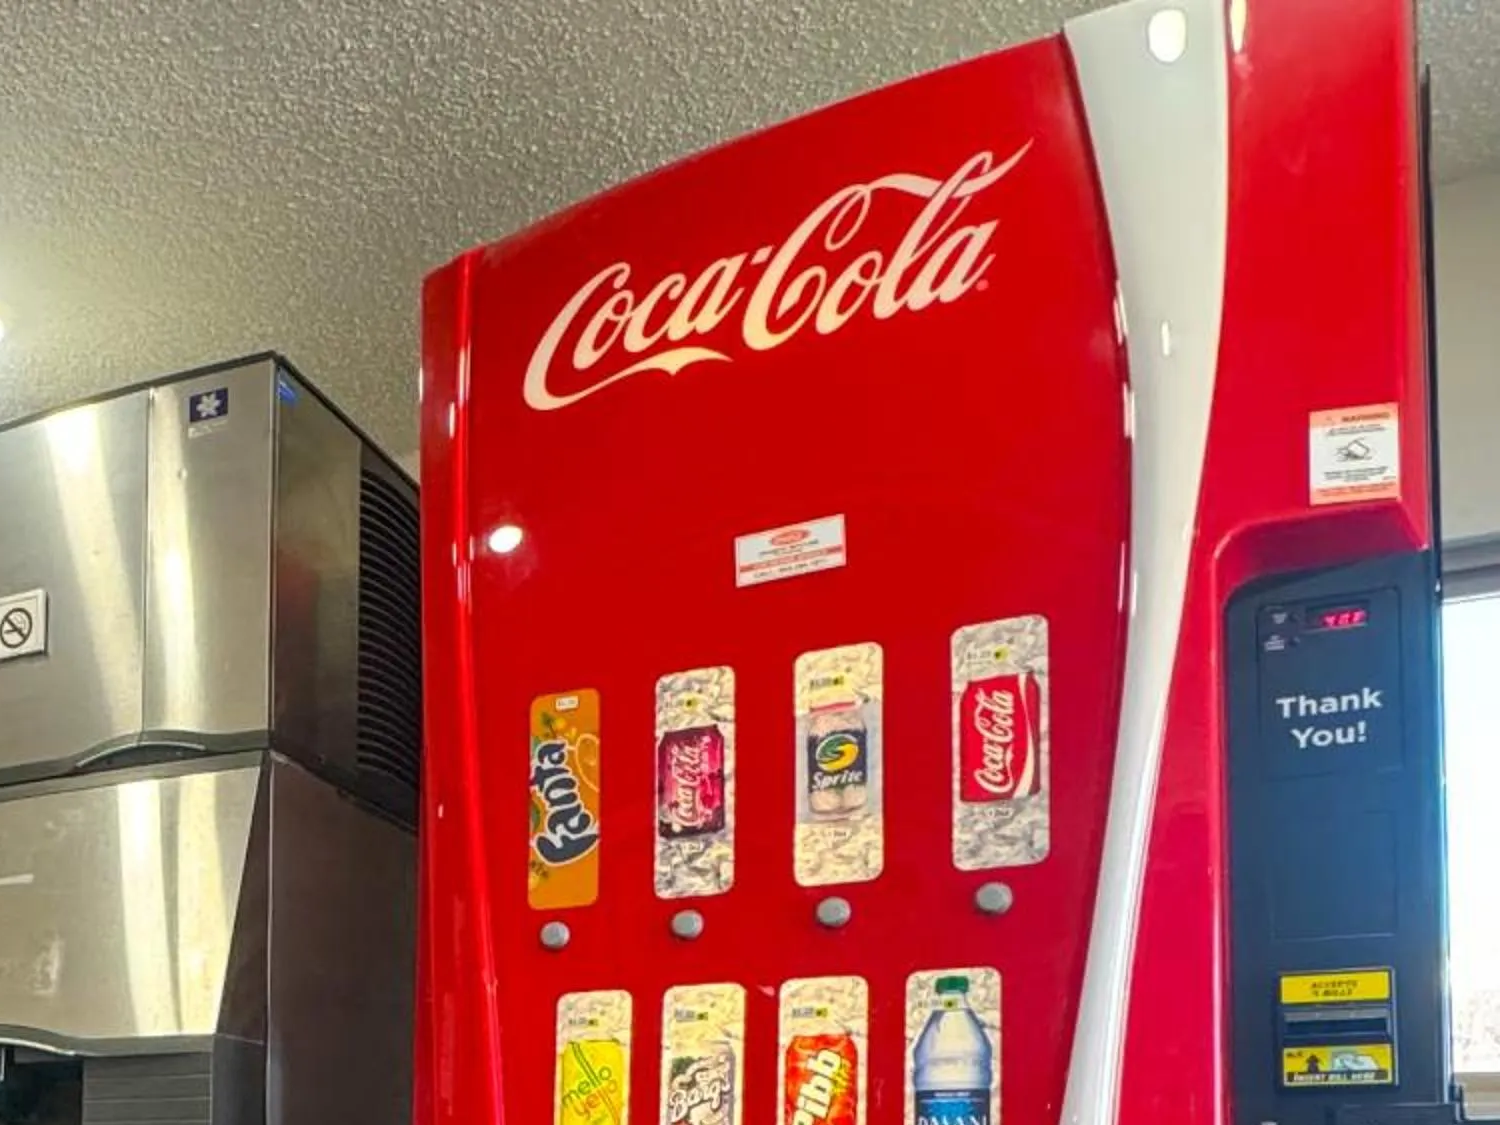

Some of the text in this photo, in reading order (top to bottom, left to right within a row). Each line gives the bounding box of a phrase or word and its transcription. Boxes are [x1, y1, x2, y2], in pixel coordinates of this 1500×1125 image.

[523, 138, 1034, 411] Coca-Cola
[1276, 687, 1383, 719] Thank
[975, 688, 1015, 793] Coca-Cola
[1290, 720, 1368, 749] You!
[531, 739, 599, 866] Fanta
[811, 768, 864, 791] Sprite
[562, 1050, 613, 1108] mello
